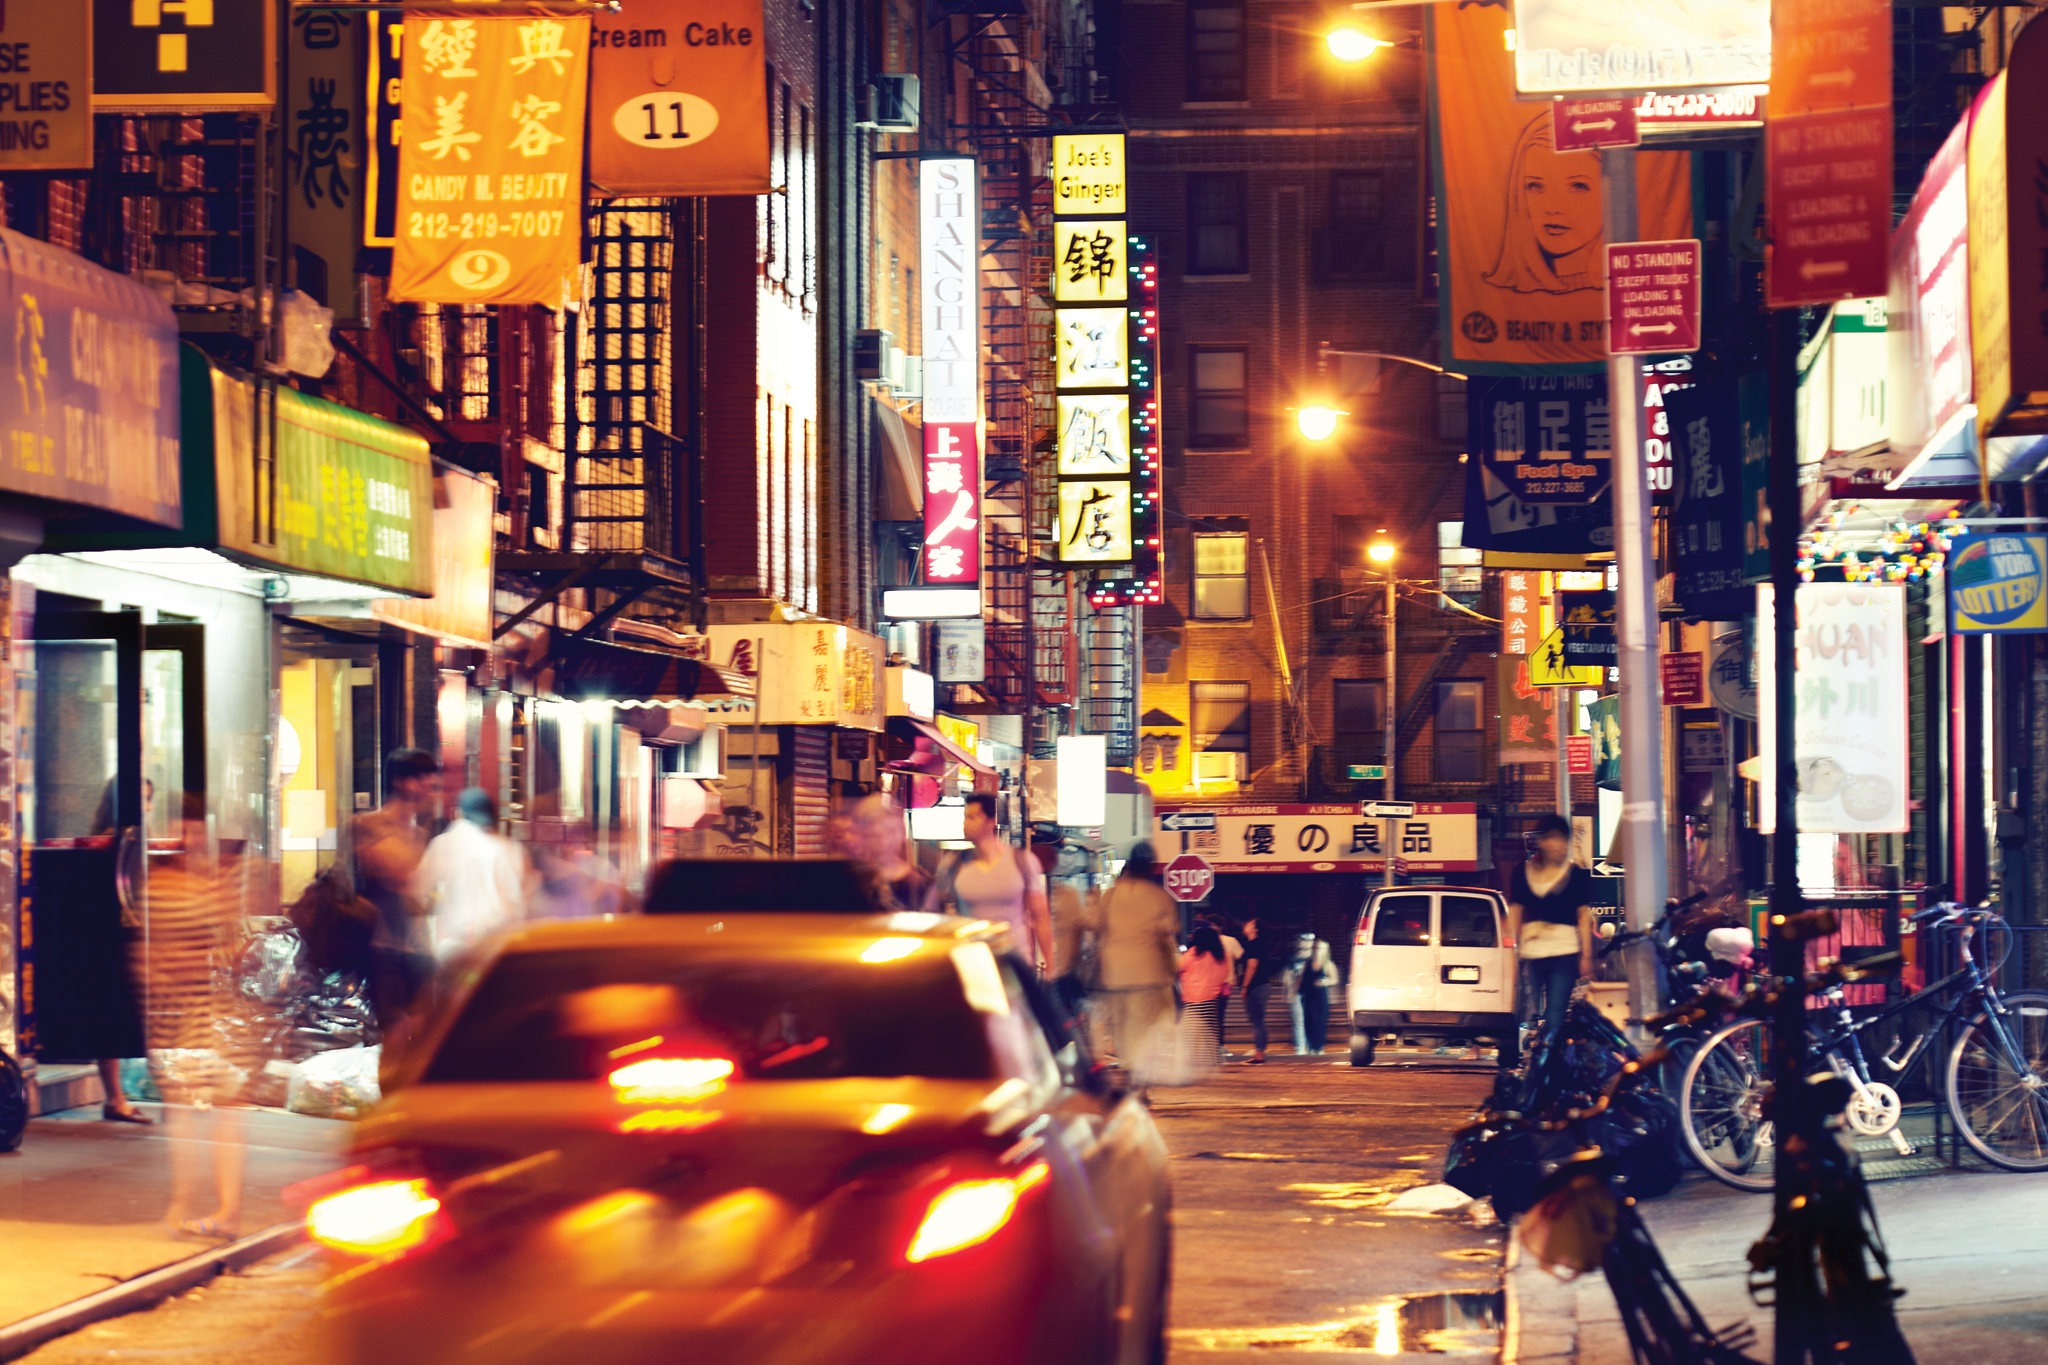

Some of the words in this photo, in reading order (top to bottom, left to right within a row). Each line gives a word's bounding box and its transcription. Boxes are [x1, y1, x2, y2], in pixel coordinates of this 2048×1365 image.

[685, 22, 753, 46] Cake
[420, 20, 573, 78] 經典
[0, 80, 71, 112] PLIES
[1565, 100, 1622, 116] UNLOADING
[419, 90, 566, 161] 美容
[642, 102, 690, 139] 11
[1067, 144, 1112, 167] Joe's
[410, 174, 467, 201] CANDY
[501, 172, 569, 200] BEAUTY
[1058, 175, 1123, 204] Ginger
[409, 211, 564, 239] 212-219-7007
[464, 254, 499, 286] 9
[1612, 255, 1630, 269] NO
[1634, 251, 1693, 268] STANDING
[933, 163, 965, 388] SHANGHAI
[1614, 275, 1651, 287] EXCEPT
[1654, 273, 1690, 286] TRUCKS
[1621, 290, 1669, 303] LOADING
[1622, 304, 1684, 318] UNLOADING
[1506, 320, 1556, 342] BEAUTY
[1580, 320, 1610, 342] STY
[1061, 229, 1130, 554] 錦江飯店
[1515, 464, 1559, 479] Foot
[1561, 462, 1598, 480] Spa
[1988, 537, 2024, 554] NEW
[1992, 553, 2036, 577] YORK
[1953, 574, 2039, 614] LOTTERY
[1507, 575, 1528, 655] 眼鏡公司
[1232, 806, 1279, 814] PARADISE
[1242, 822, 1432, 856] 優の良品
[1168, 868, 1211, 887] STOP
